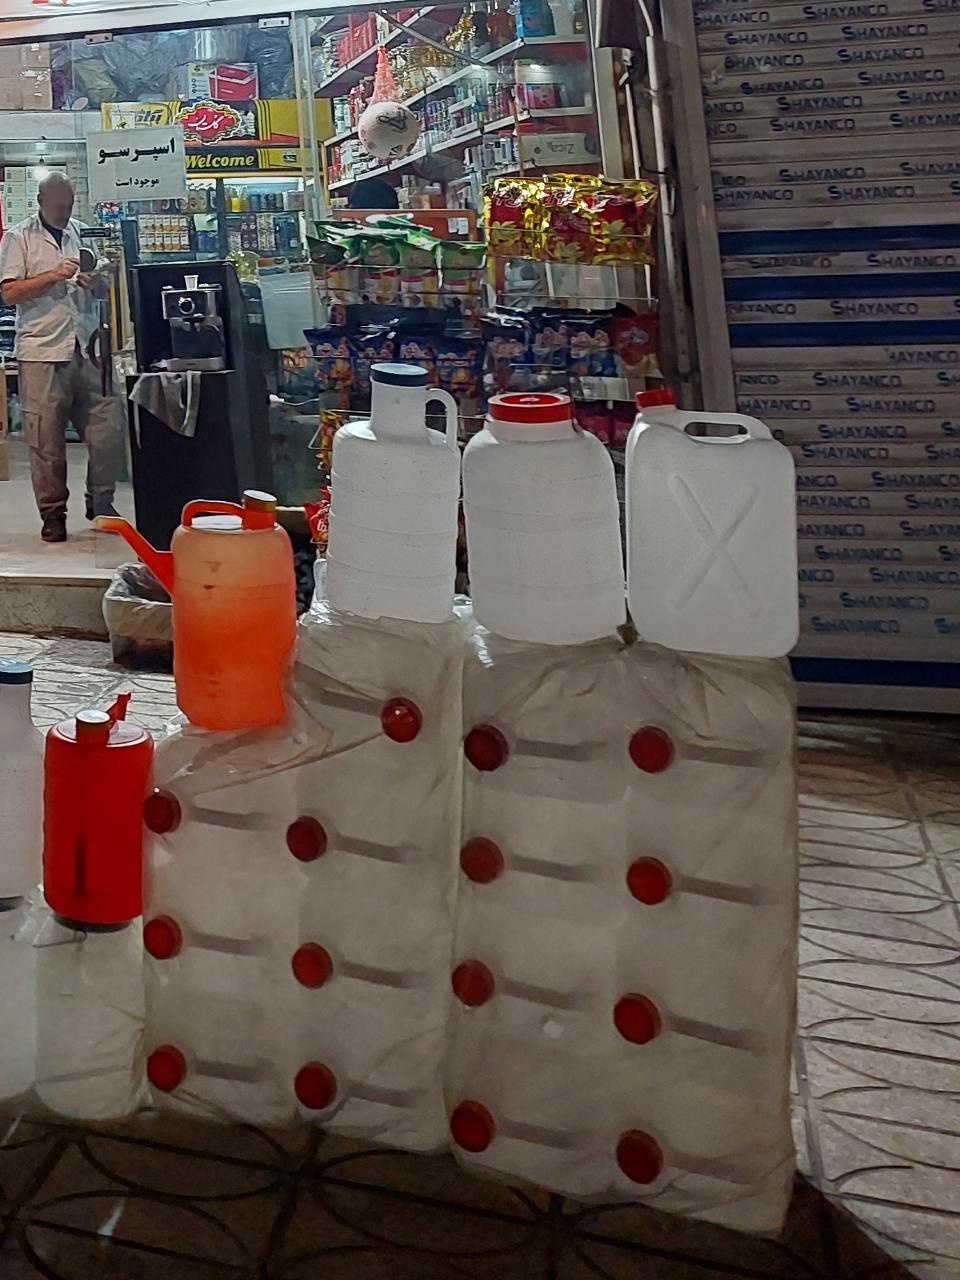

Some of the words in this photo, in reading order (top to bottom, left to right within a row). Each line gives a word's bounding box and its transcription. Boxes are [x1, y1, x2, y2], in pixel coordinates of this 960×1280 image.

[803, 5, 888, 20] SHAYANCO
[724, 32, 808, 45] SHAYANCO
[841, 24, 928, 41] SHAYANCO
[837, 47, 924, 63] SHAYANCO
[740, 78, 824, 95] SHAYANCO
[857, 69, 945, 85] SHAYANCO
[705, 101, 743, 114] ANCO
[776, 95, 863, 111] SHAYANCO
[897, 90, 960, 105] SHAYAN
[770, 118, 855, 132] SHAYANCO
[890, 113, 960, 127] SHAYAN
[97, 136, 175, 165] اسپرسو
[185, 153, 255, 169] Welcome
[778, 167, 865, 182] SHAYANCO
[899, 161, 960, 177] SHAYA
[115, 176, 133, 188] است
[134, 177, 160, 189] موجود
[827, 185, 915, 200] SHAYANCO
[866, 254, 955, 268] SHAYANCO
[728, 302, 797, 315] HAYANCO
[830, 301, 918, 316] SHAYANCO
[886, 349, 959, 364] HAYANCO
[737, 374, 779, 385] ANCO
[813, 372, 902, 387] SHAYANCO
[740, 400, 811, 412] HAYANCO
[846, 397, 936, 412] SHAYANCO
[818, 424, 906, 439] SHAYANCO
[801, 443, 889, 460] SHAYANCO
[797, 475, 837, 487] ANCO
[797, 495, 870, 509] HAYANCO
[904, 494, 960, 510] SHAYA
[798, 524, 865, 537] HAYANCO
[900, 520, 960, 537] SHAYA
[815, 545, 902, 561] SHAYANCO
[869, 567, 959, 584] SHAYANCO
